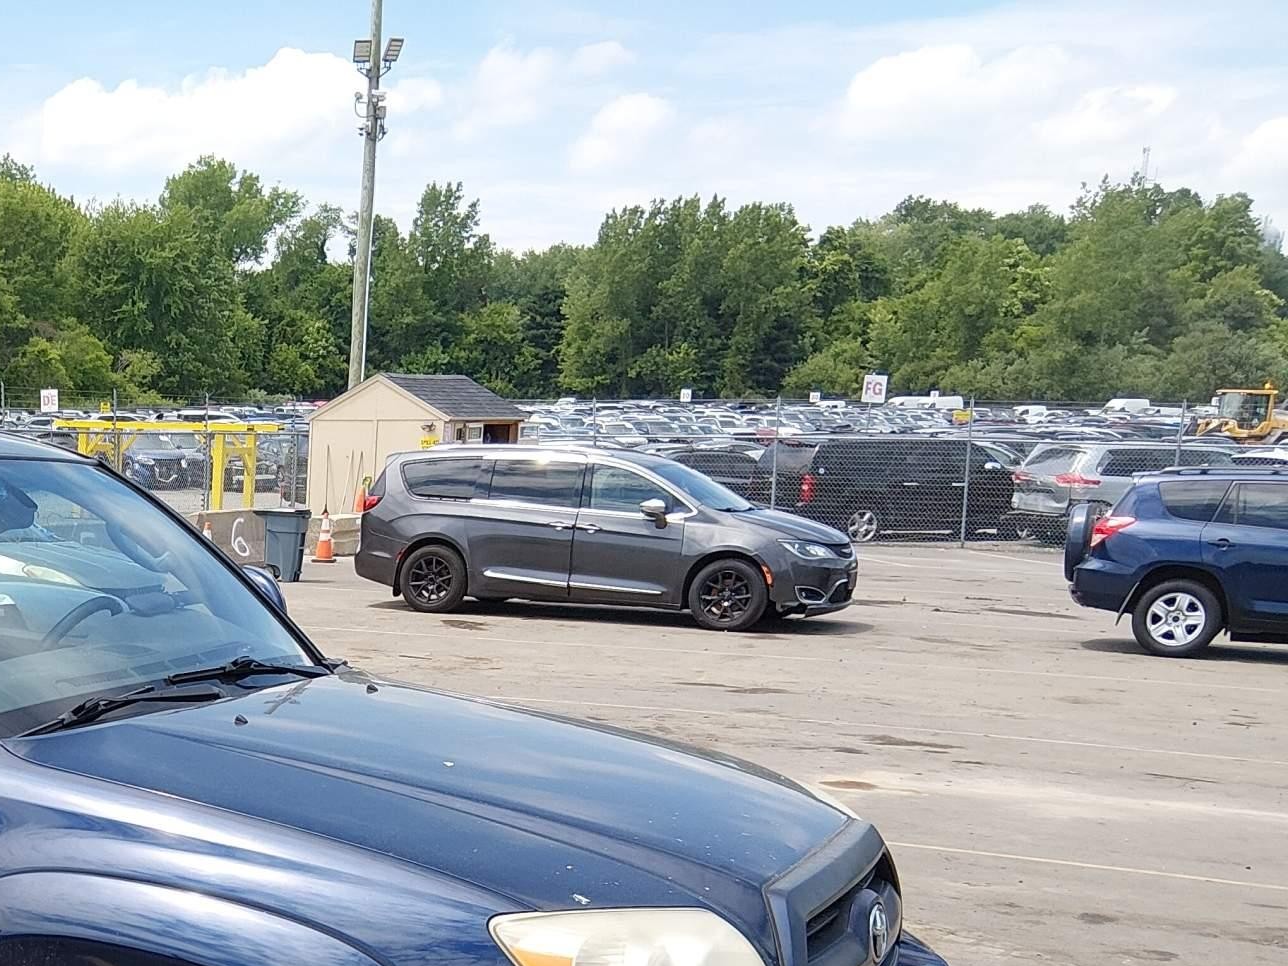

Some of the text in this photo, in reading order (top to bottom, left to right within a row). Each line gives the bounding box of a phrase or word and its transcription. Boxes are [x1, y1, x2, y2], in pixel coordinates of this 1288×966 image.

[865, 381, 883, 396] FG
[42, 395, 57, 406] DE
[231, 517, 250, 557] 6
